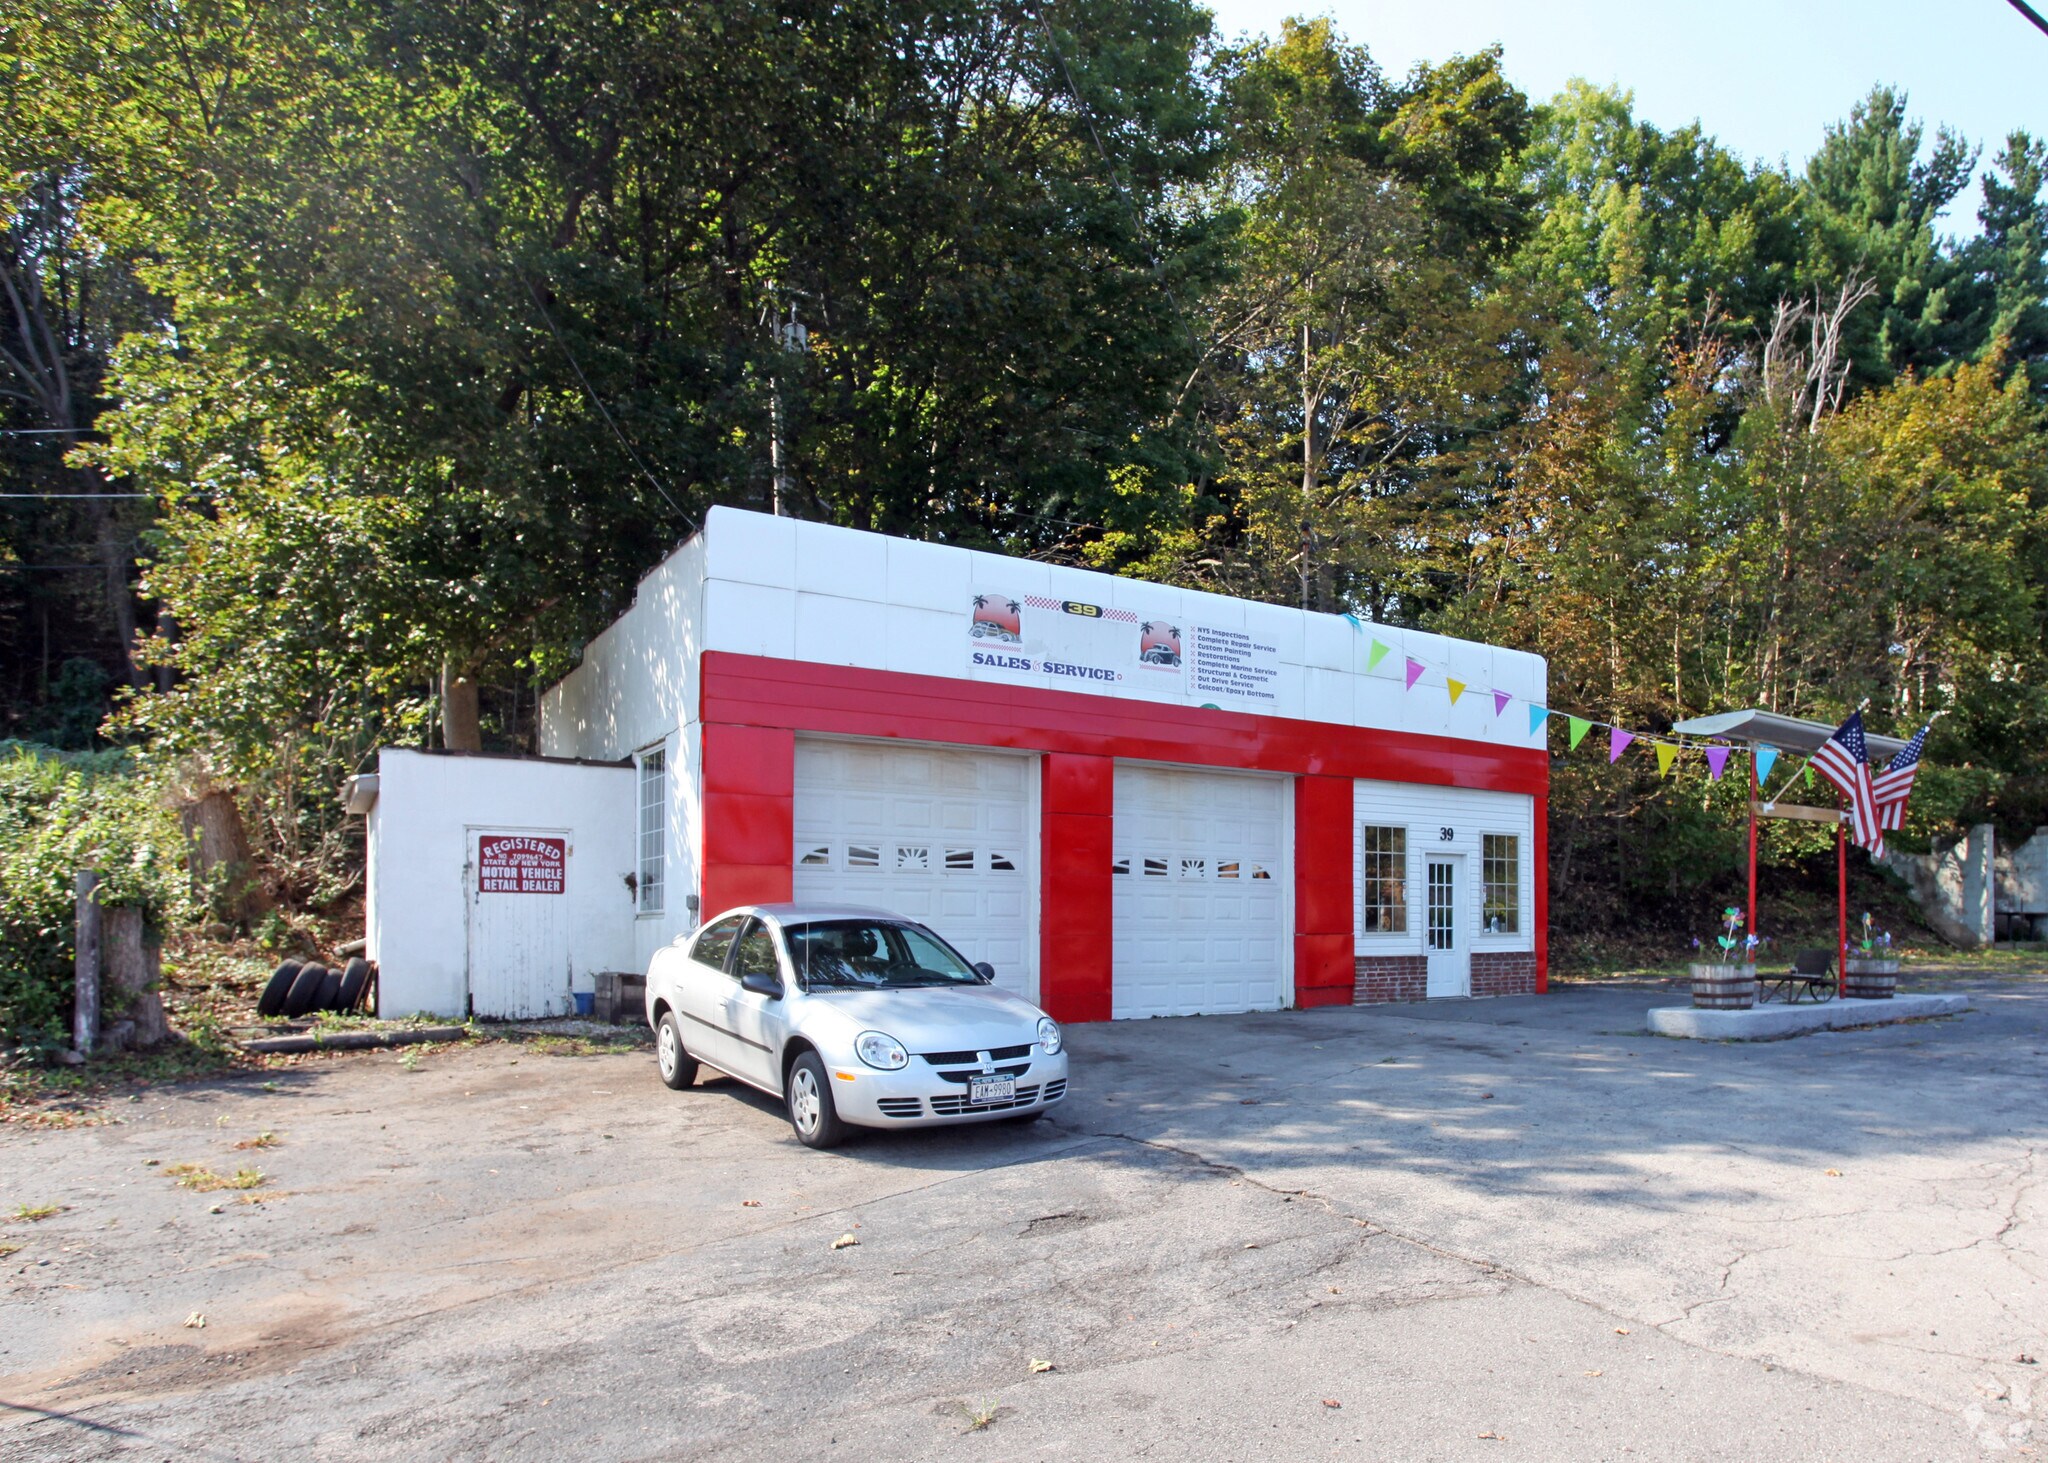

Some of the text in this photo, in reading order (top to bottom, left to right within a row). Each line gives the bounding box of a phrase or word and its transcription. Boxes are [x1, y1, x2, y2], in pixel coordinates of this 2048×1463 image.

[1068, 602, 1097, 617] 39
[1197, 627, 1249, 640] NYS Inspections
[1197, 635, 1277, 653] Complete Repair Service
[1197, 643, 1252, 657] Custom Painting
[1197, 651, 1240, 663] Restorations
[972, 652, 1115, 681] SALES & SERVICE
[1197, 659, 1277, 676] Complete Marine Service
[1197, 667, 1231, 677] Structural
[1239, 673, 1269, 683] Cosmetic
[1197, 675, 1254, 689] Out Drive Service
[1197, 683, 1275, 699] Gelcoat/Epoxy Bottoms
[1439, 827, 1454, 841] 39
[483, 838, 561, 860] REGISTERED
[481, 866, 562, 879] MOTOR VEHICLE
[483, 879, 560, 891] RETAIL DEALER
